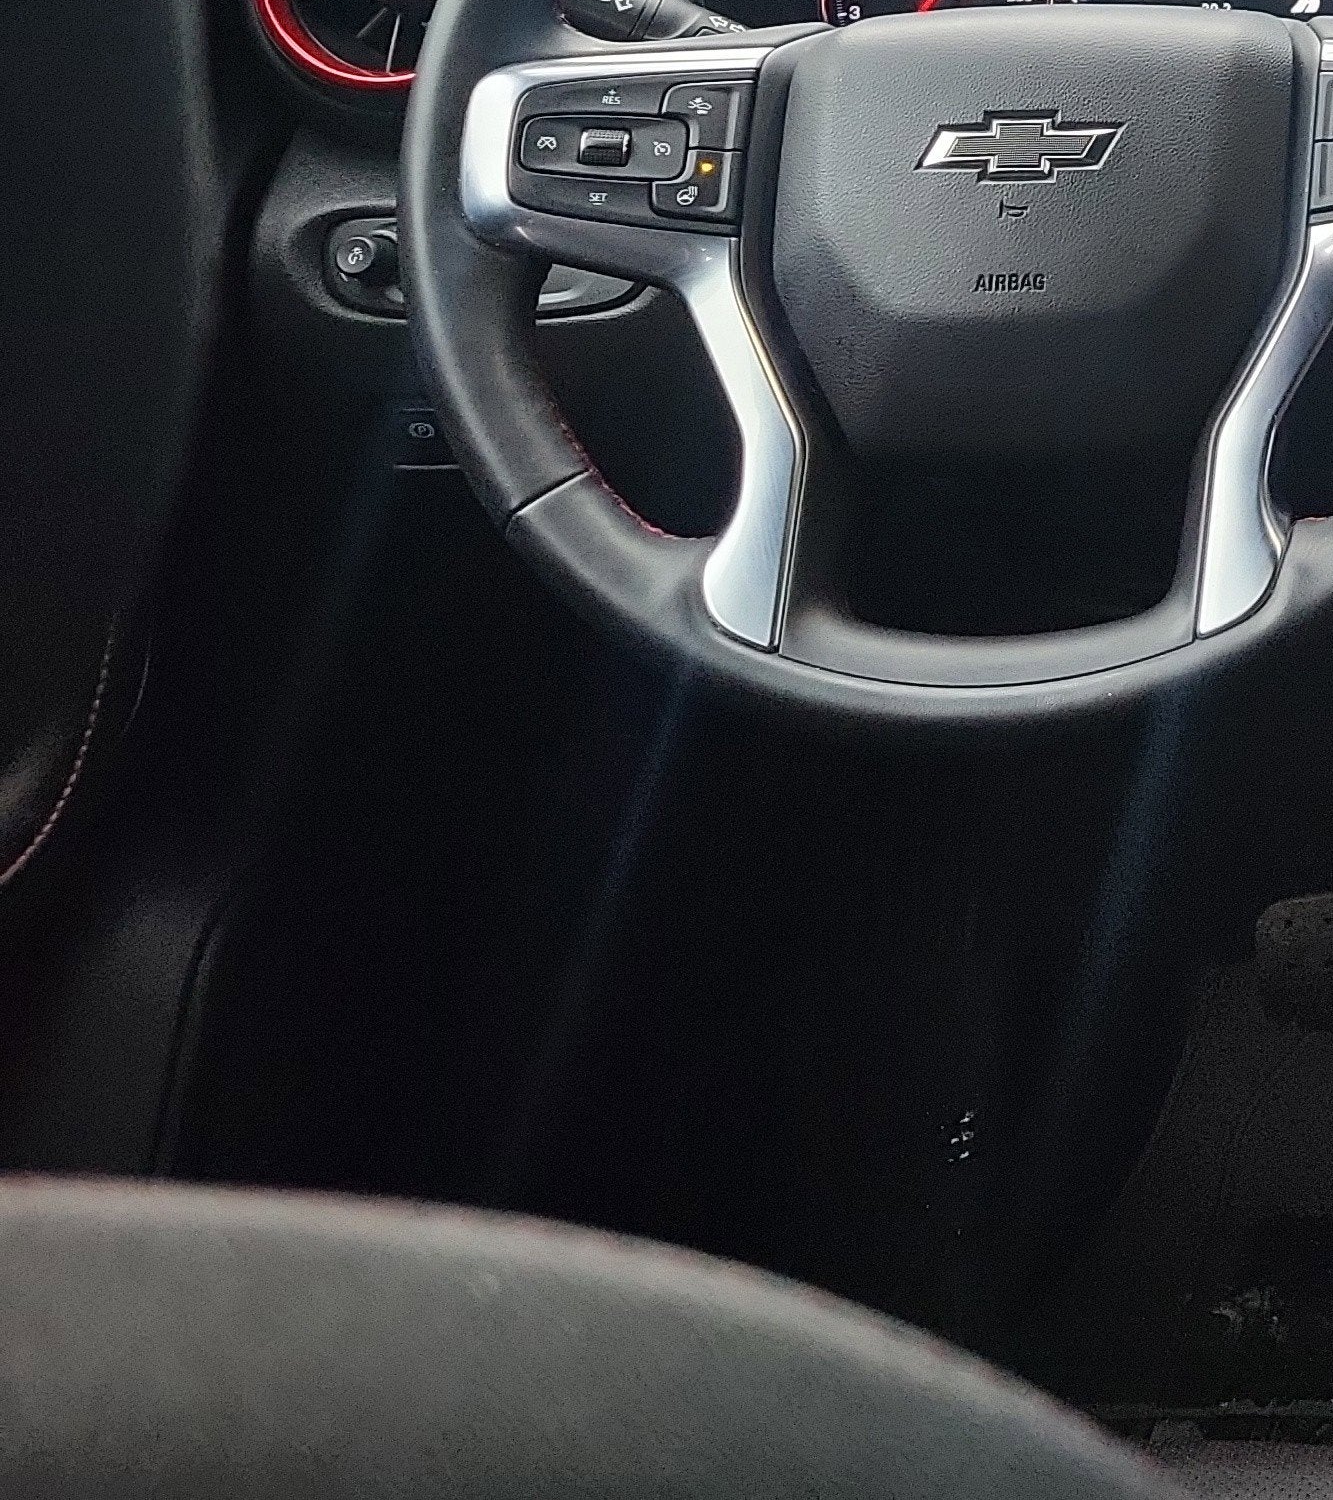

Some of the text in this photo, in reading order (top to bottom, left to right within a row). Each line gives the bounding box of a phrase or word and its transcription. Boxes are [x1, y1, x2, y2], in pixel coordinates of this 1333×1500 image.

[849, 5, 861, 19] 3
[602, 95, 621, 104] RES
[589, 192, 608, 202] SET
[972, 274, 1046, 293] AIRBAG
